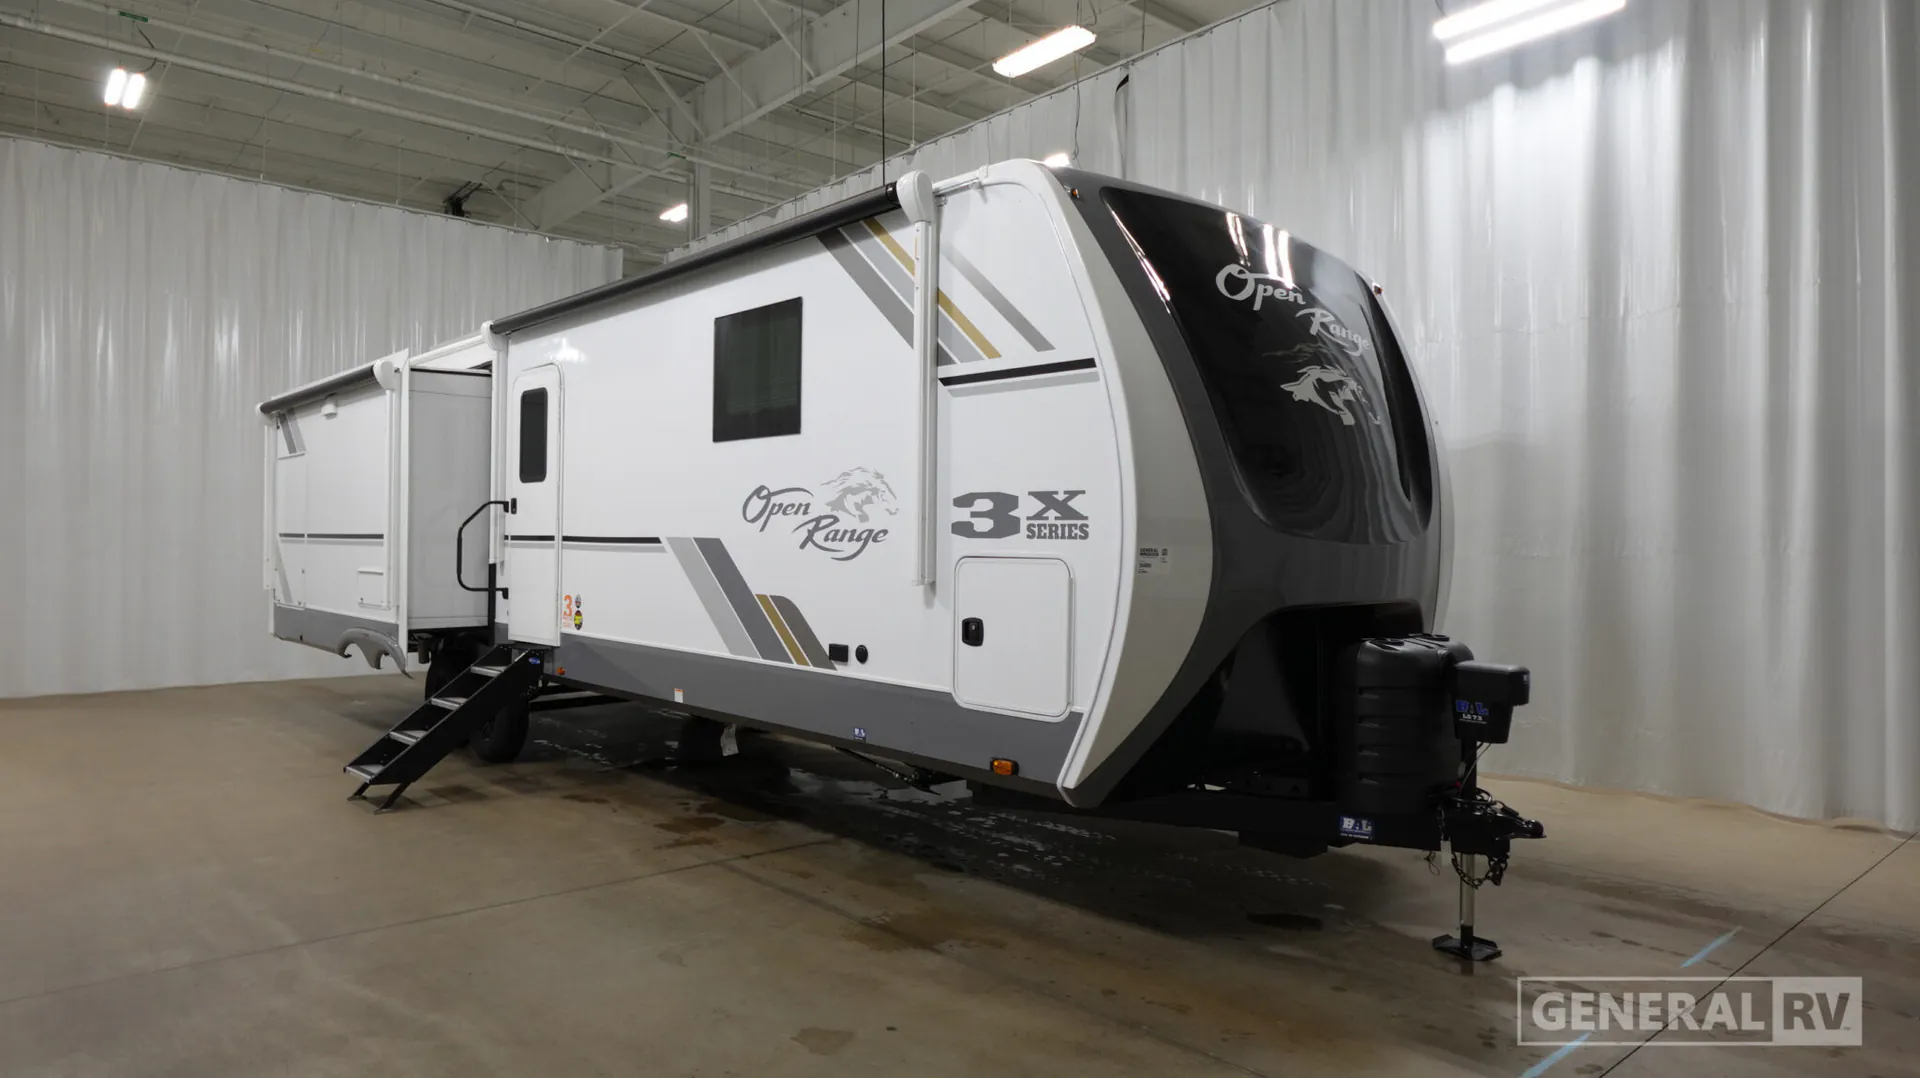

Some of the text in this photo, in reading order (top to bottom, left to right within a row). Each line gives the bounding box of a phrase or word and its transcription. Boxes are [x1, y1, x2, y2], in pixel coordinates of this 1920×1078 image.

[1216, 263, 1306, 311] Open
[1295, 308, 1371, 357] Range
[742, 484, 814, 532] Open
[1026, 523, 1089, 540] SERIES
[791, 514, 889, 561] Range
